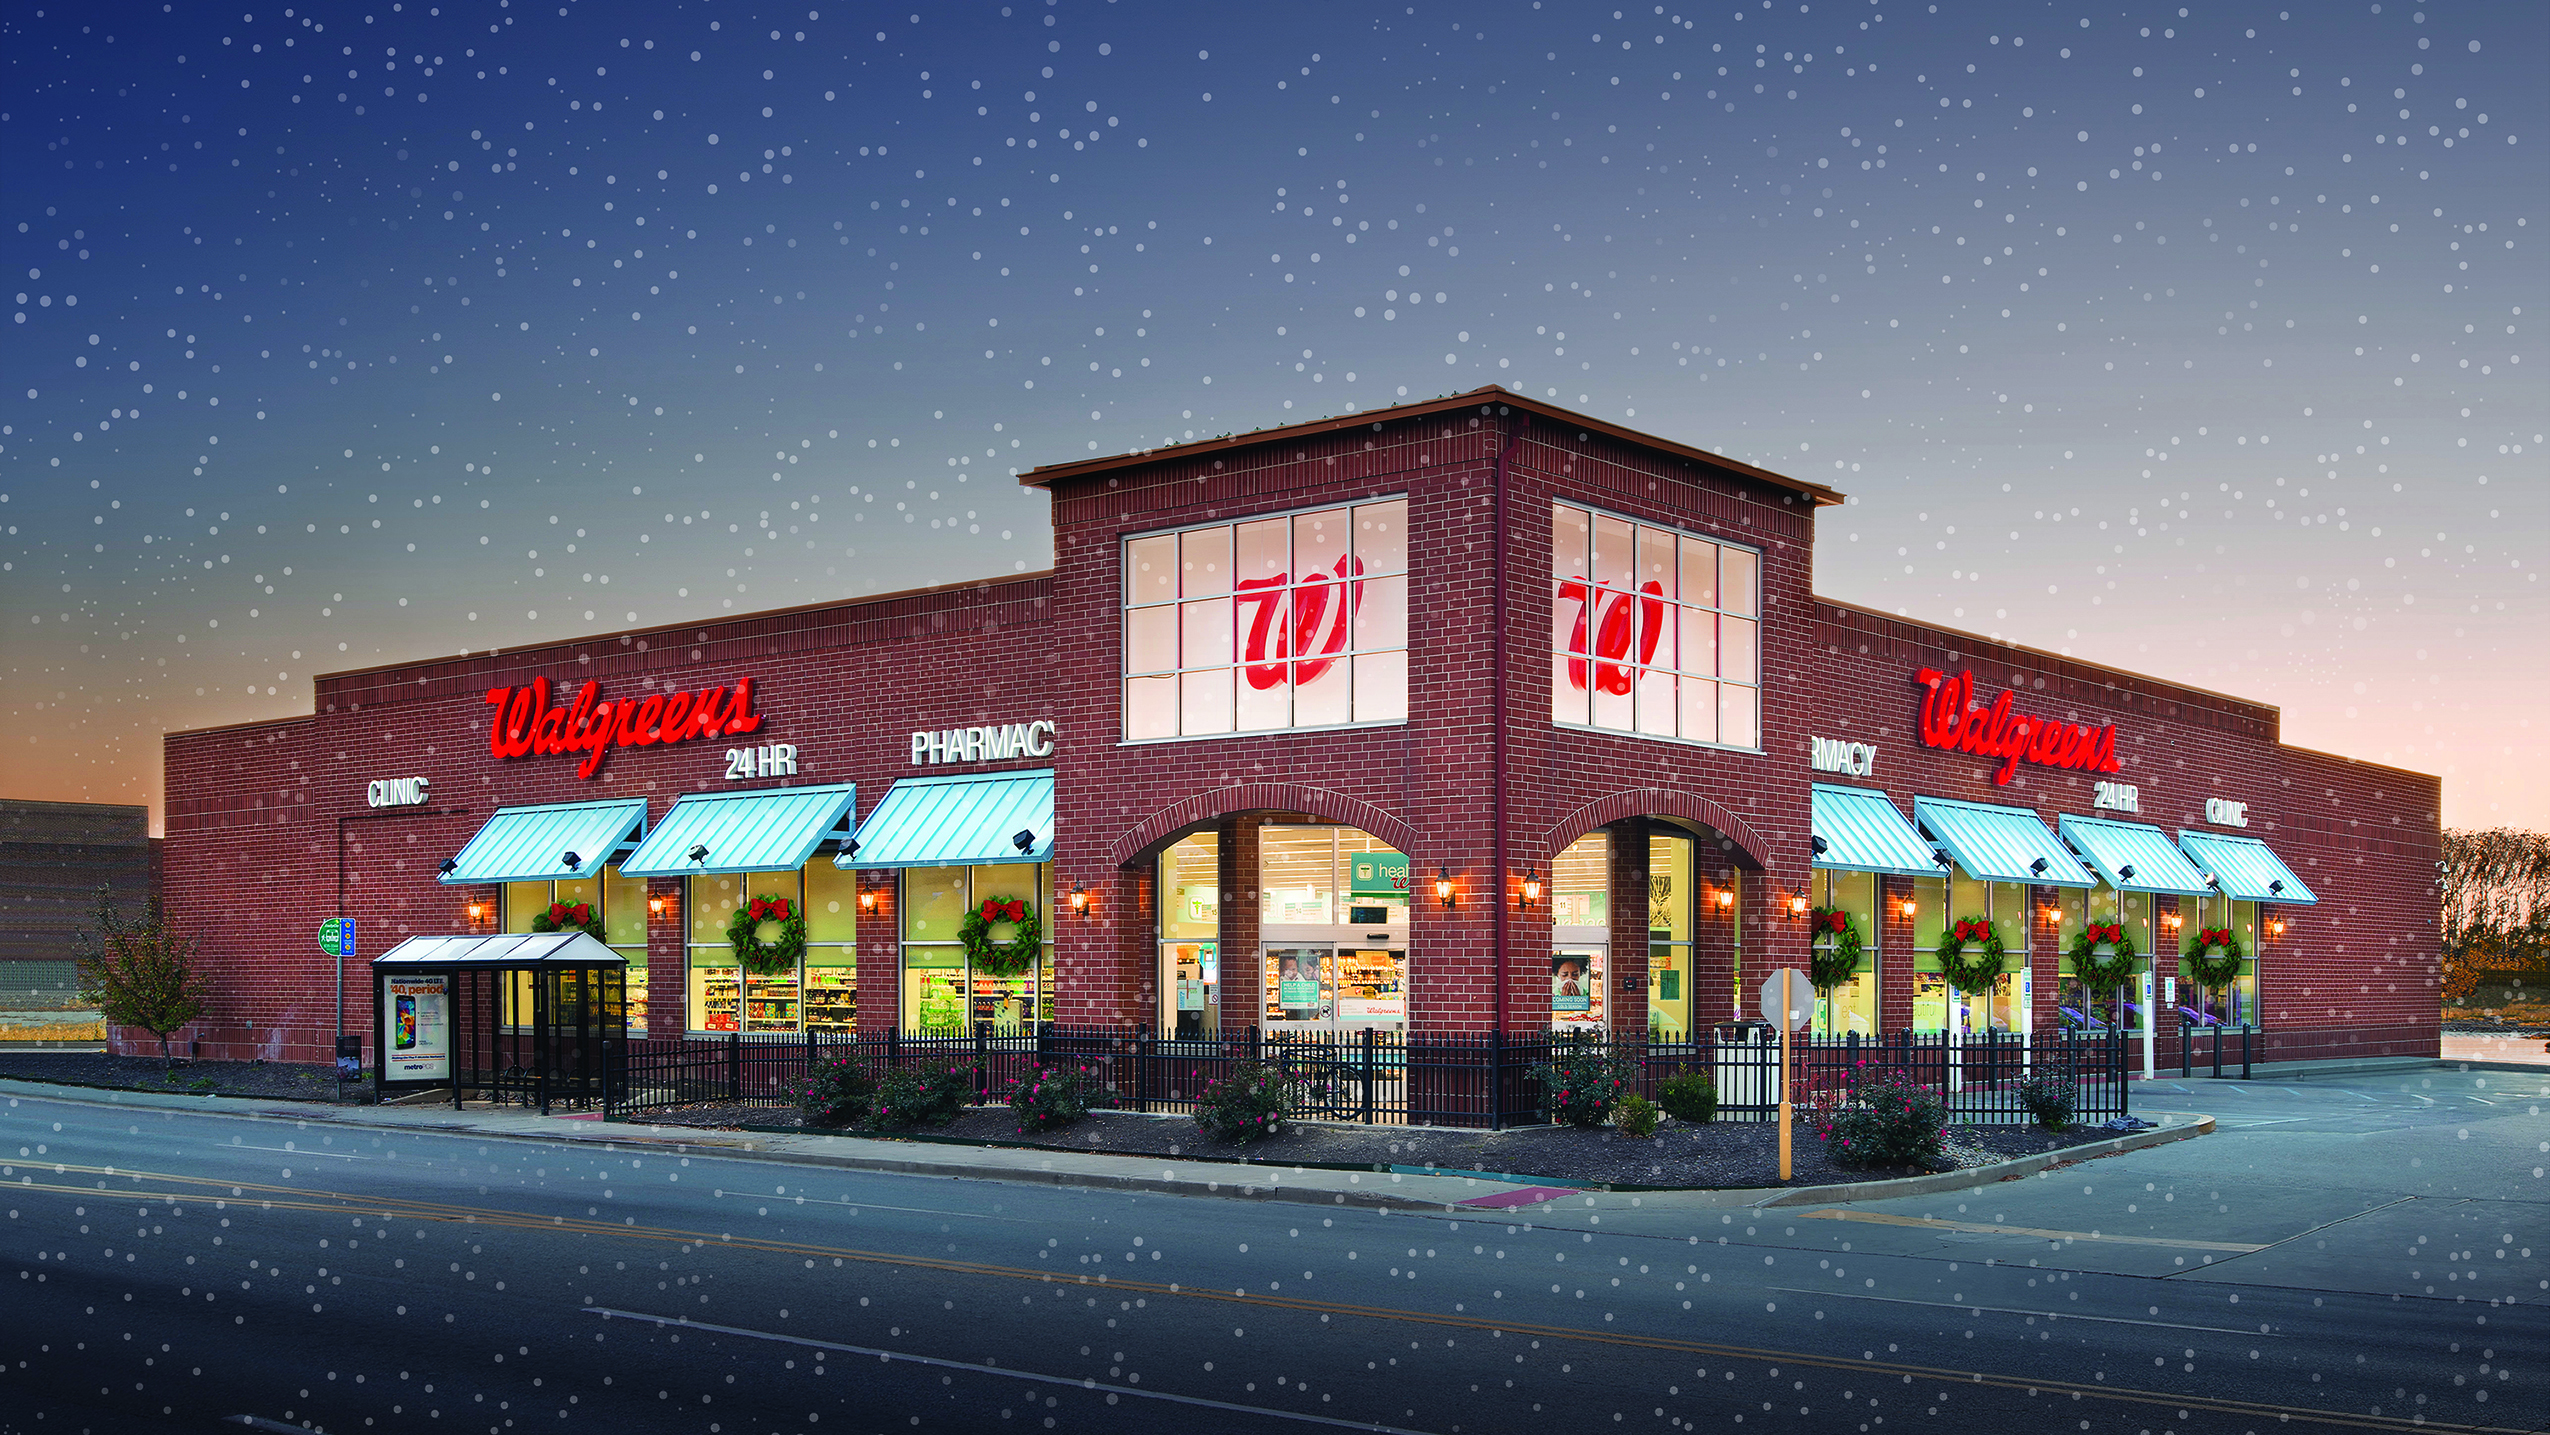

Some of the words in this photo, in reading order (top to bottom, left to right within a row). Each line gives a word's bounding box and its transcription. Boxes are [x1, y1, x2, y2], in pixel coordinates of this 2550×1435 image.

[486, 676, 765, 780] Walgreens
[911, 720, 1055, 765] PHARMAC
[1913, 667, 2122, 785] Walgreens
[725, 747, 757, 779] 24
[759, 744, 797, 777] HR
[367, 776, 430, 808] CLINIC
[2094, 780, 2116, 809] 24
[2119, 783, 2139, 812] HR
[2205, 797, 2249, 828] CLINIC
